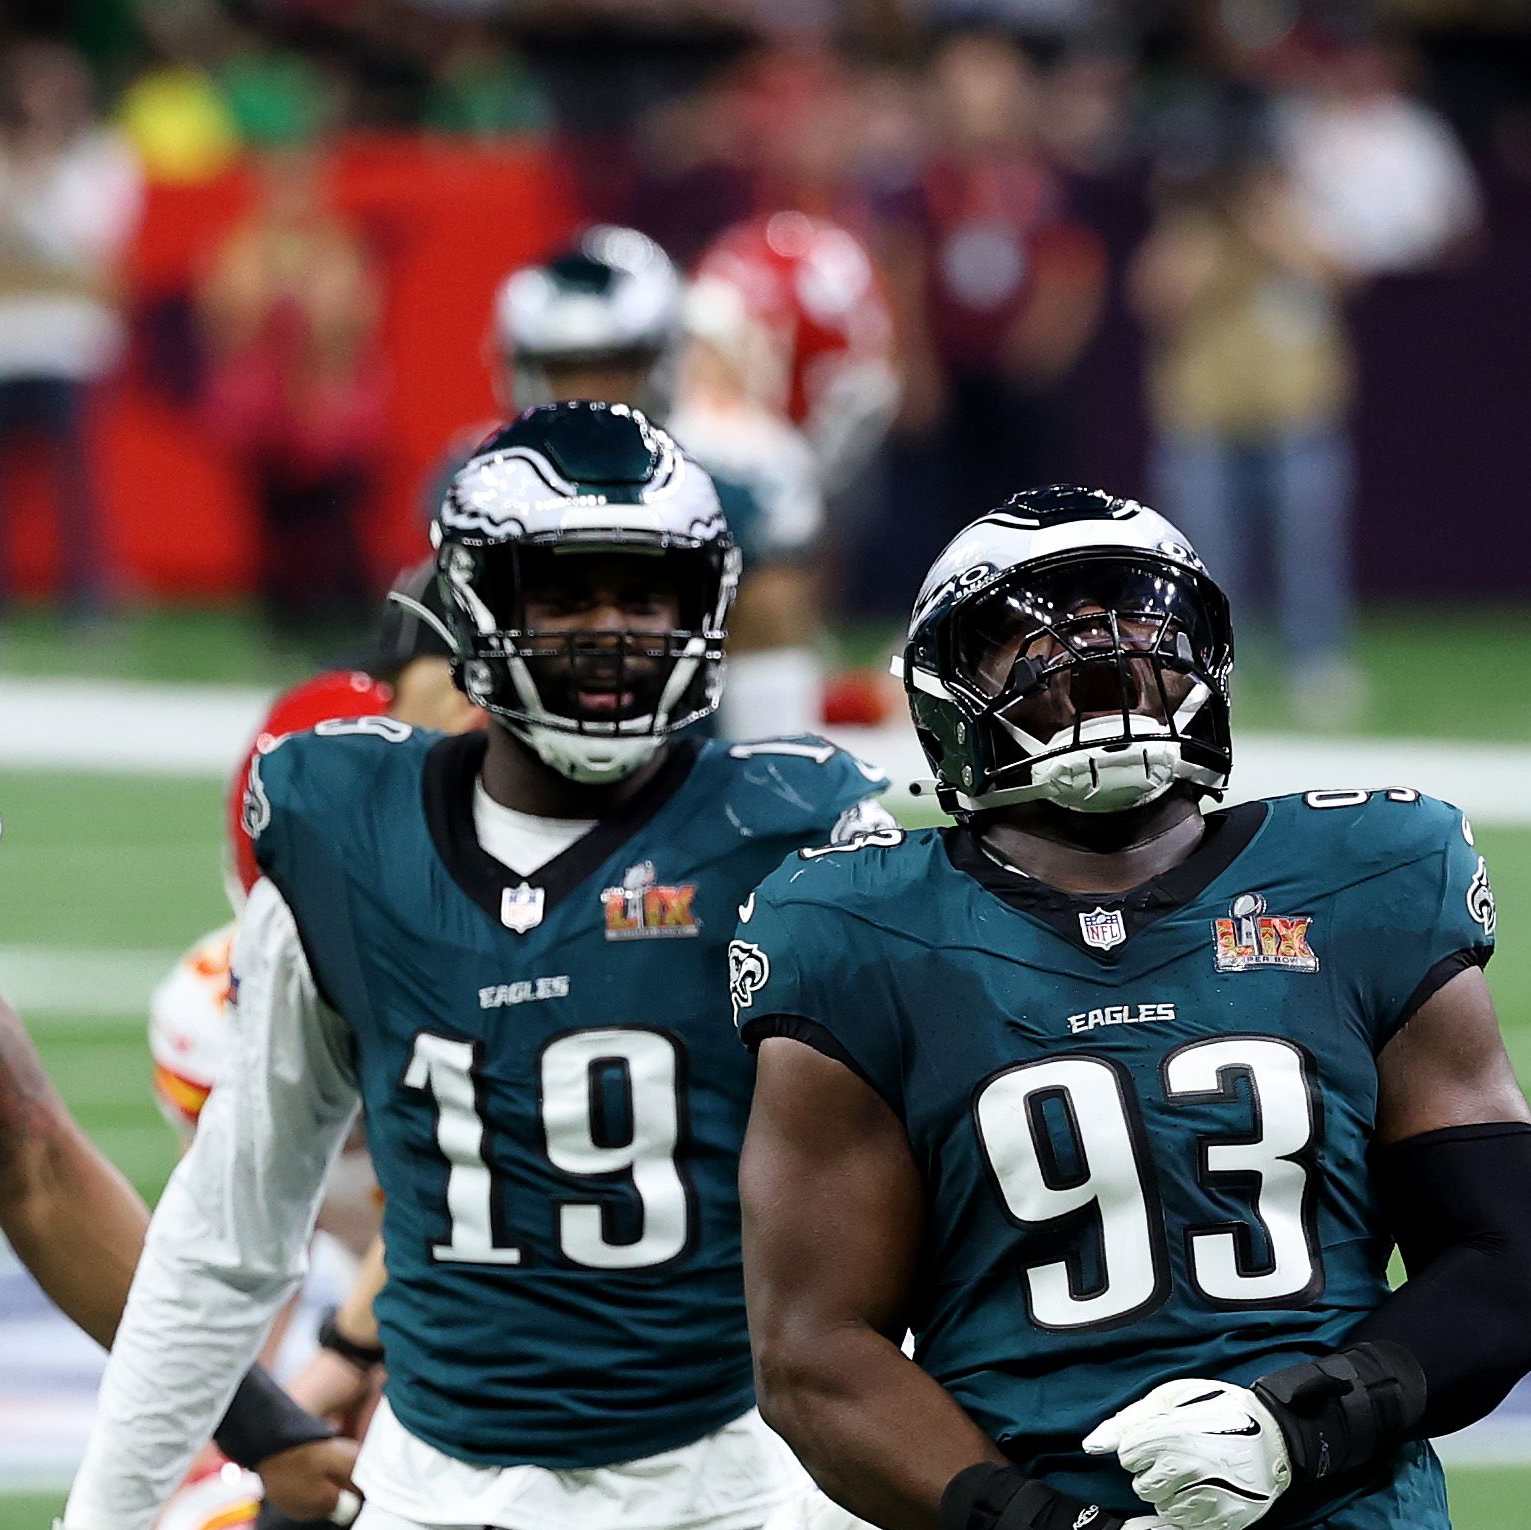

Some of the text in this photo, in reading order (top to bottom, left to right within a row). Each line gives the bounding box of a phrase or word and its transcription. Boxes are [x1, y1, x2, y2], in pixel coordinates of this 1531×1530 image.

[1090, 925, 1118, 941] NFL
[1215, 917, 1311, 957] LIX
[478, 975, 571, 1010] EAGLES
[1066, 1003, 1176, 1034] EAGLES
[402, 1028, 690, 1270] 19
[973, 1036, 1316, 1329] 93
